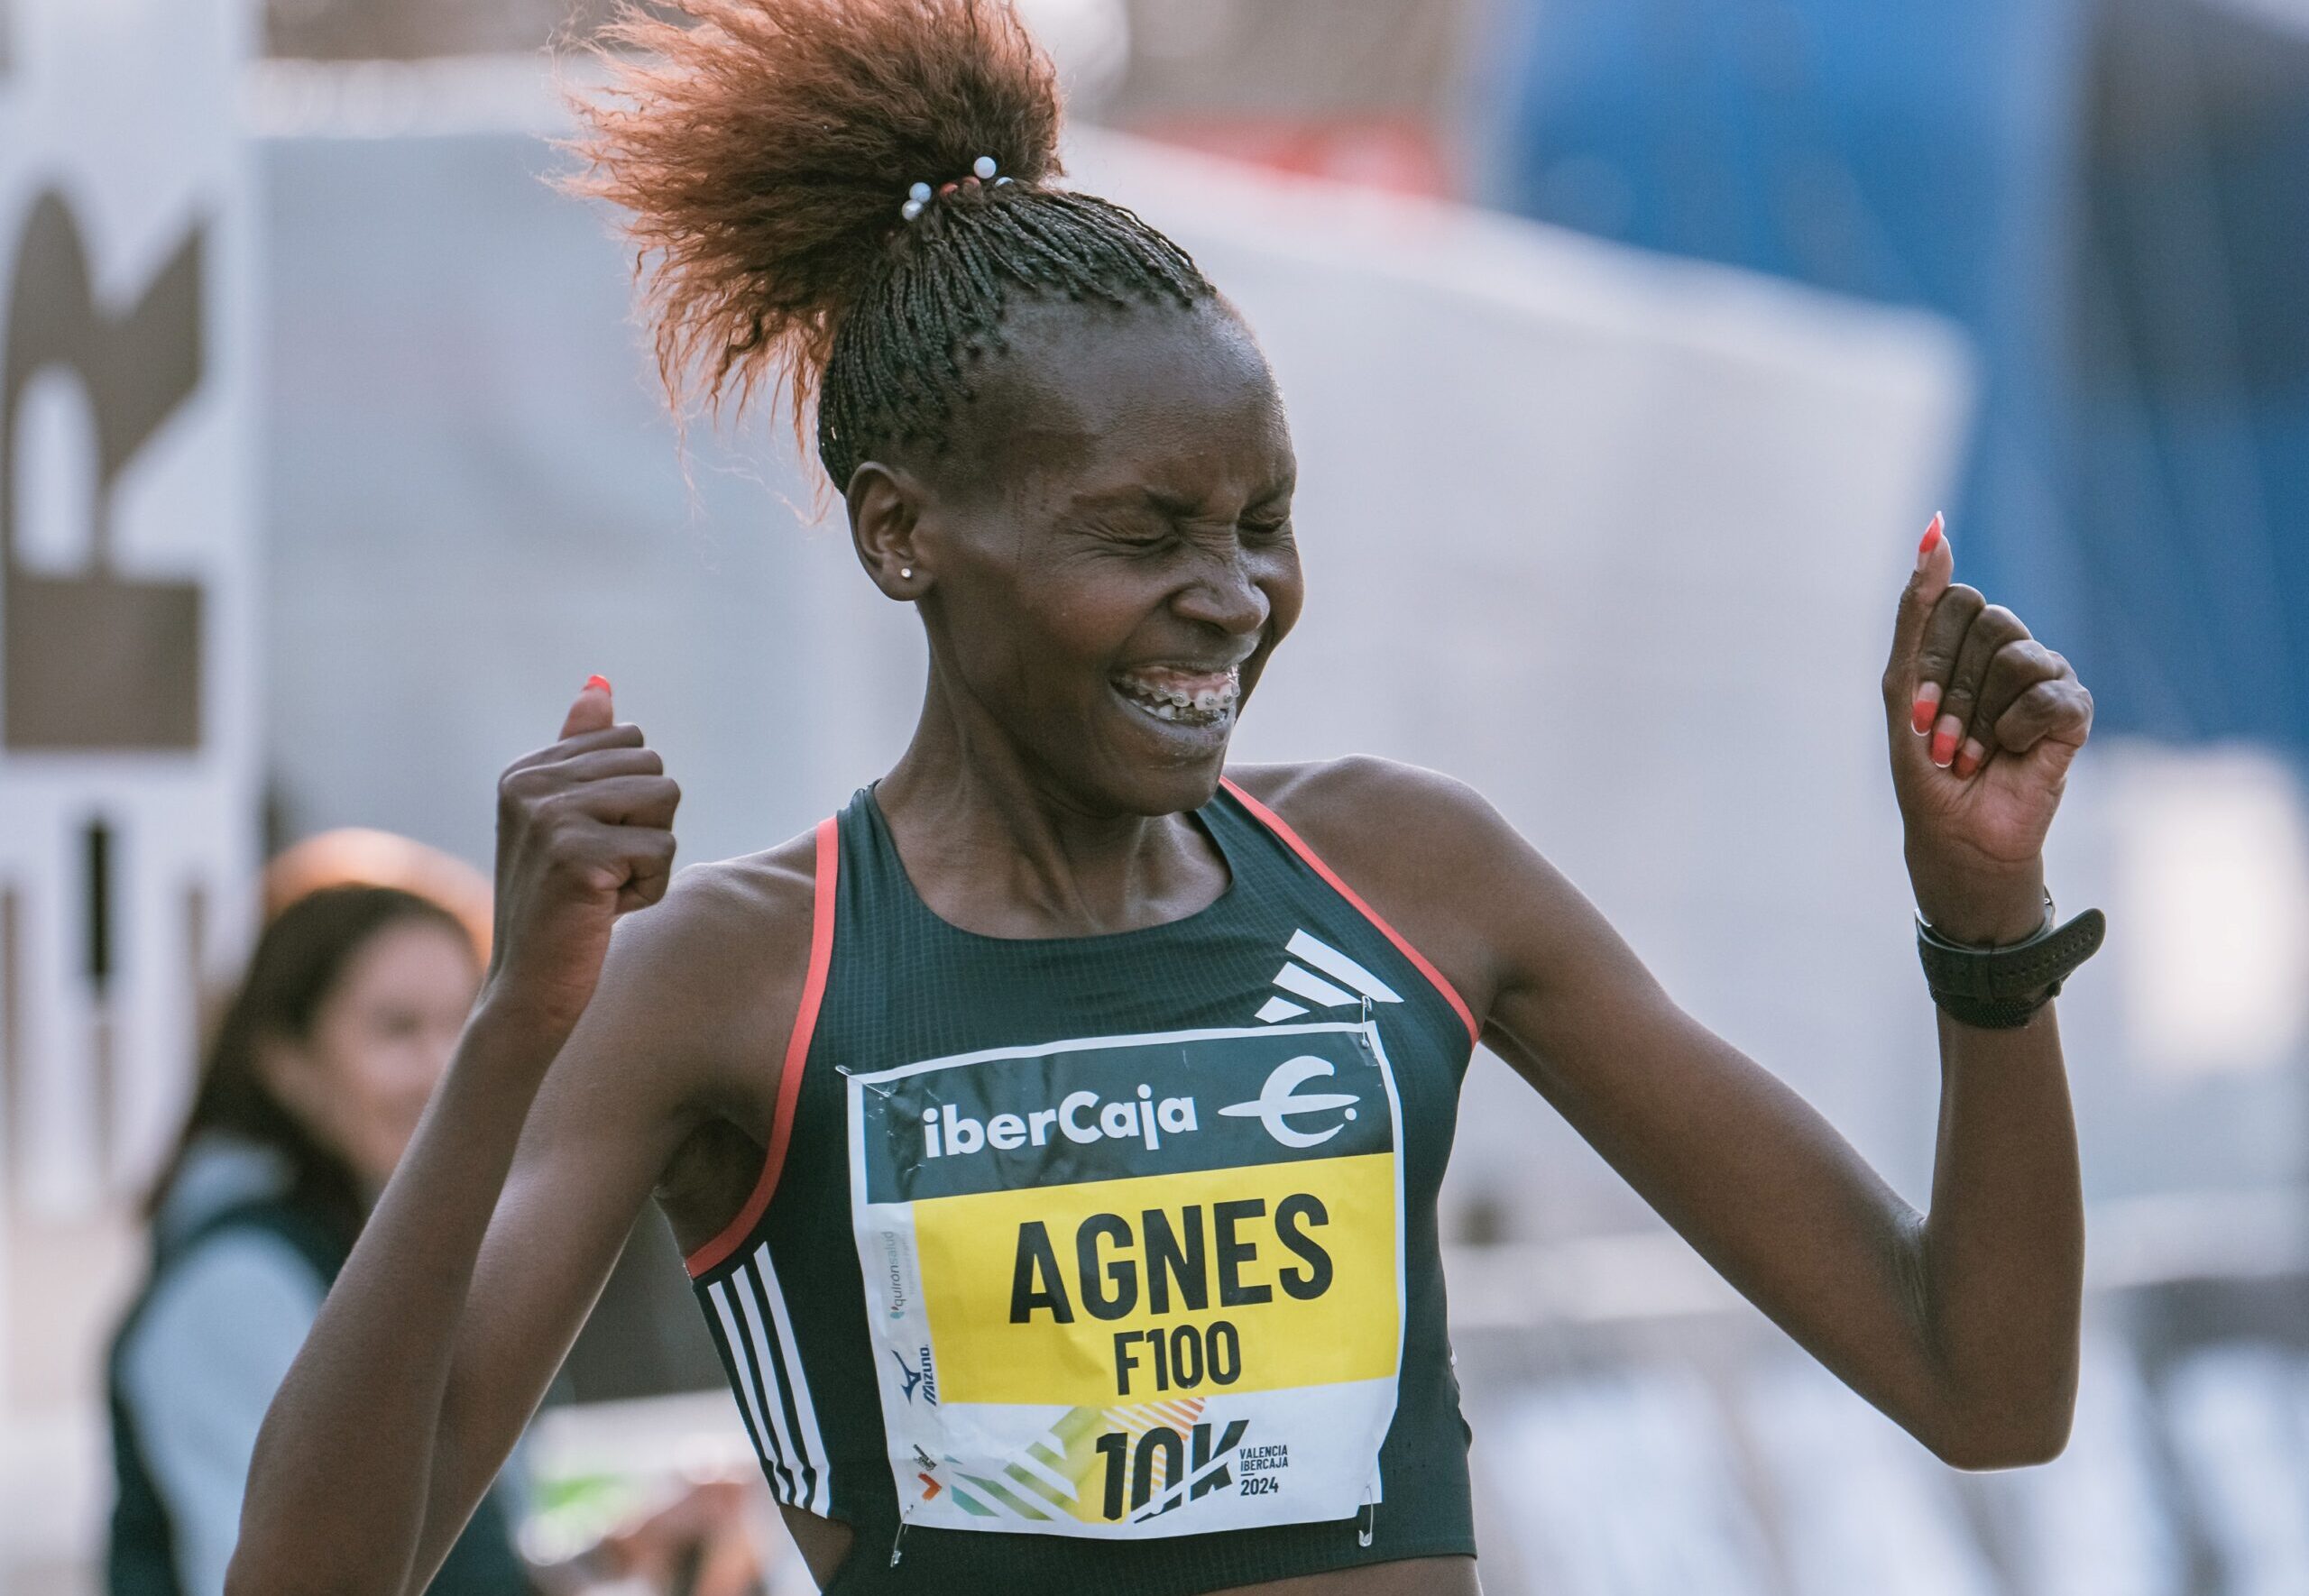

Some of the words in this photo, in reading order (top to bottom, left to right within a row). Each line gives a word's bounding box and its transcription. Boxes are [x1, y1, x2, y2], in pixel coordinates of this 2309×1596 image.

[922, 1084, 1198, 1158] iberCaja
[1008, 1193, 1334, 1325] AGNES
[1113, 1321, 1241, 1397] F100
[1096, 1419, 1250, 1524] 10K
[1239, 1445, 1288, 1459] VALENCIA
[1240, 1456, 1289, 1472] IBERCAJA
[1240, 1476, 1279, 1496] 2024
